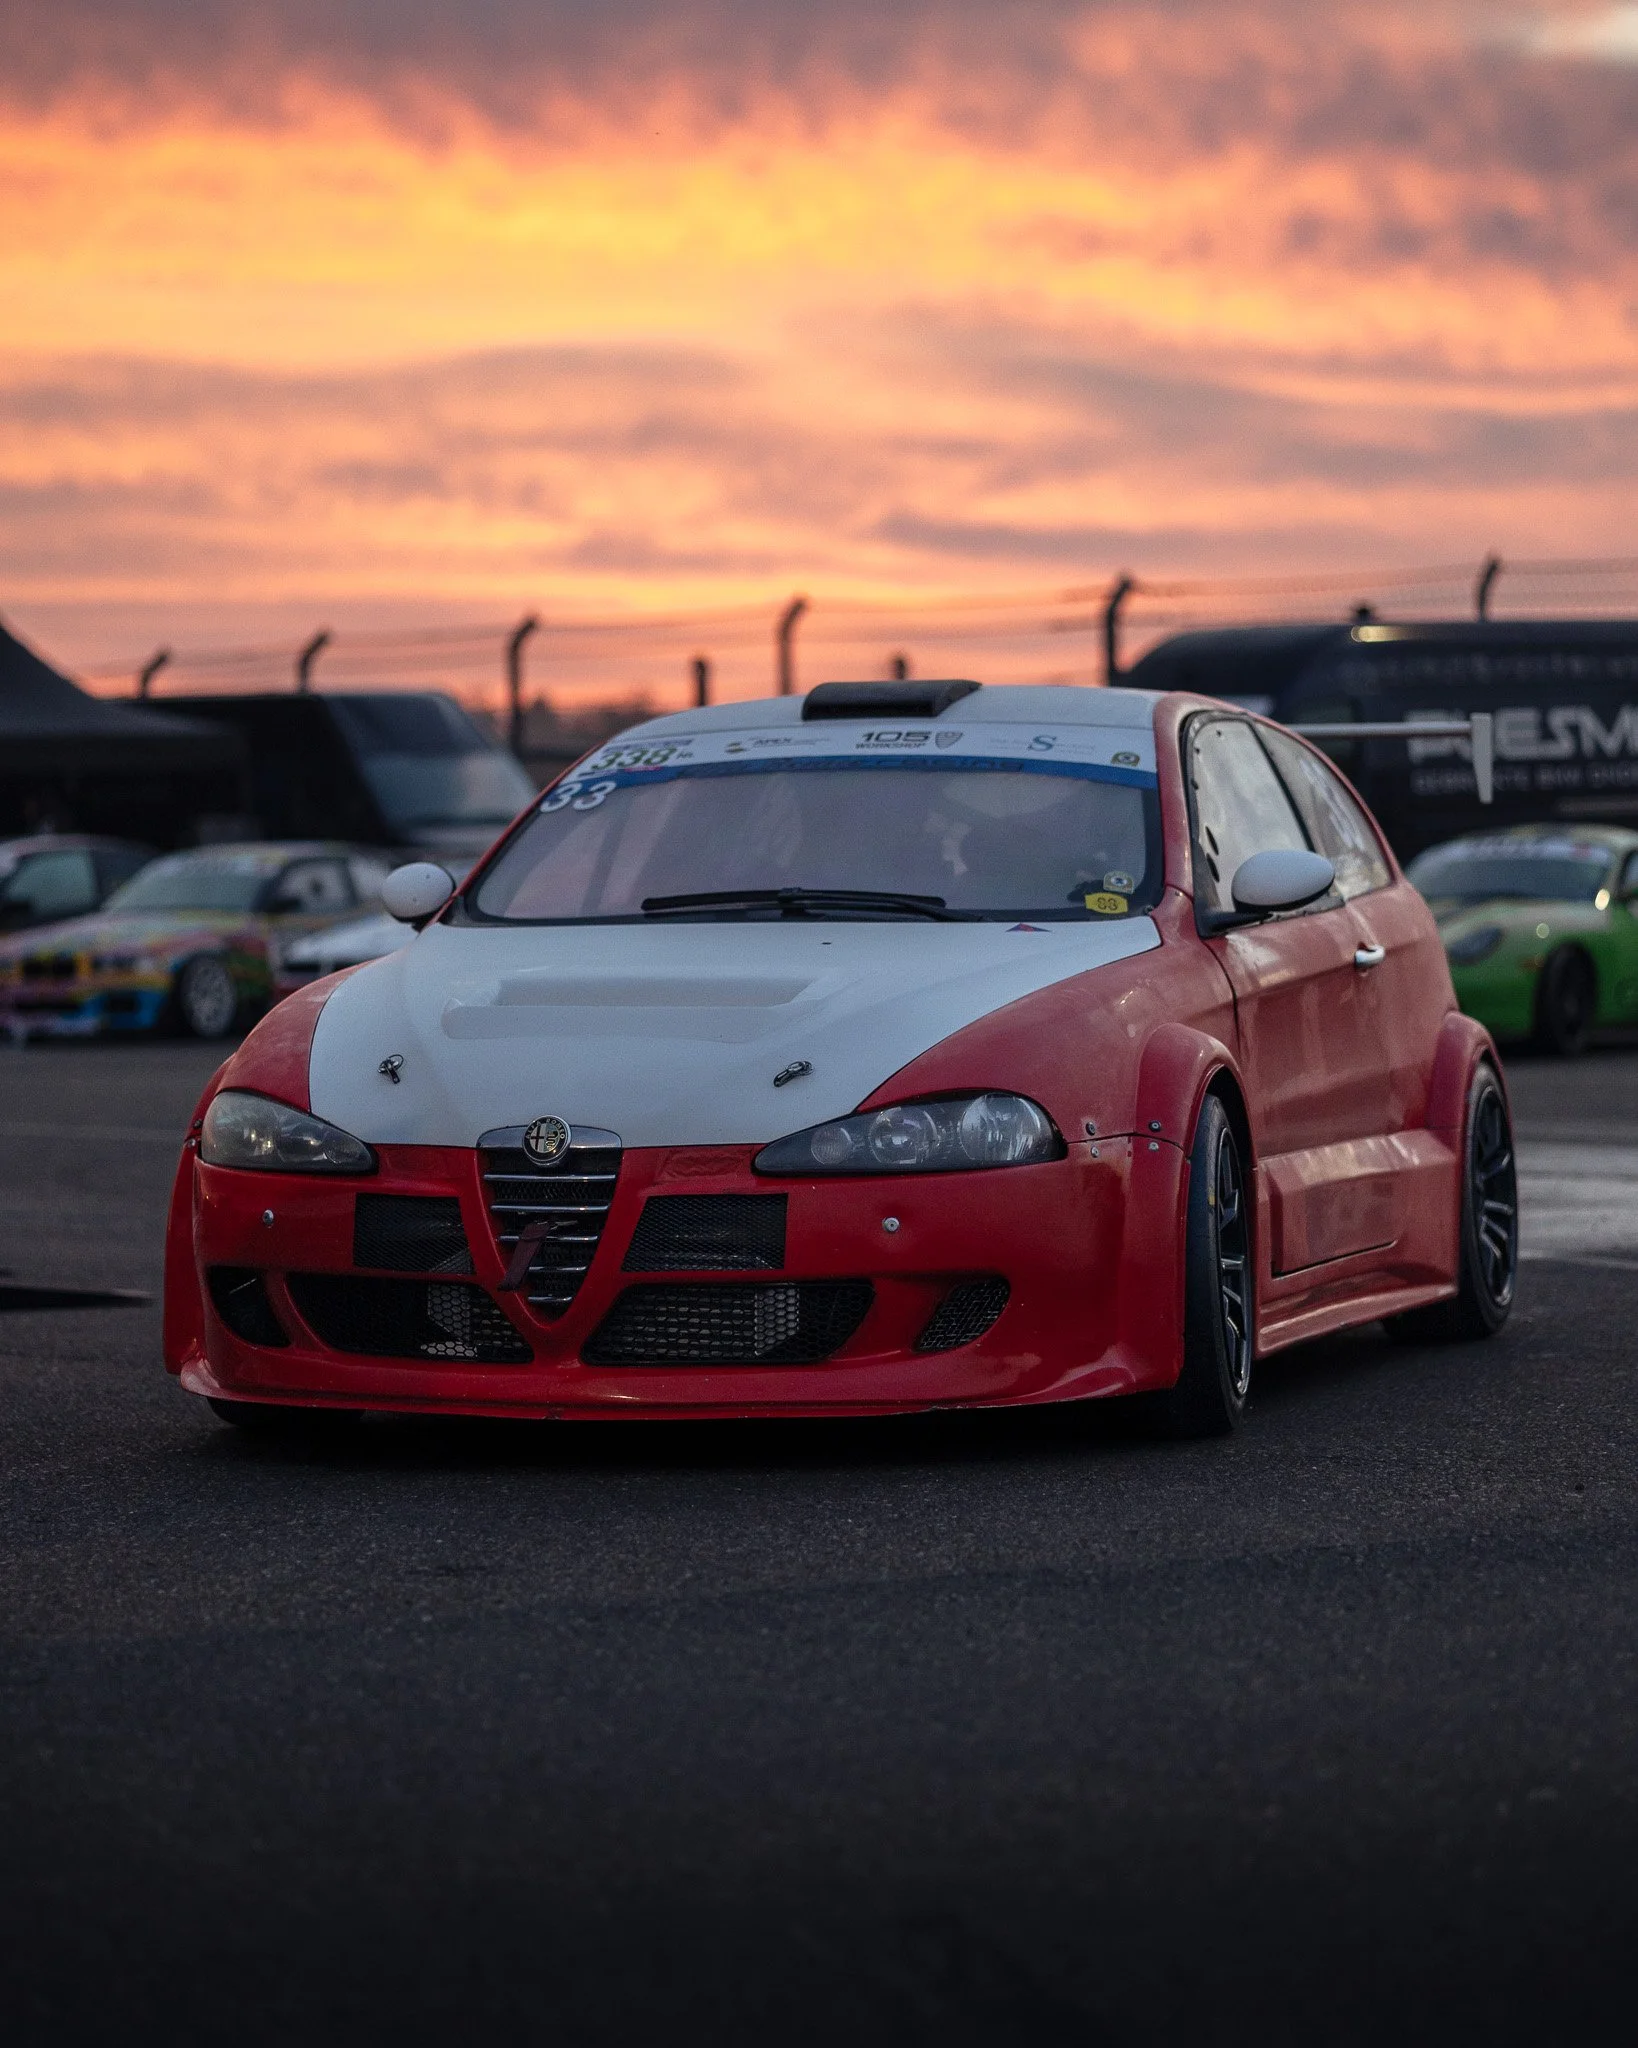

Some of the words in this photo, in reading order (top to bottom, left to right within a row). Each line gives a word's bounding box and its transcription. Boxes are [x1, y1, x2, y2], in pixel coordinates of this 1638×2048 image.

[862, 731, 932, 742] 105
[1027, 735, 1057, 751] S
[591, 746, 677, 770] 338
[540, 781, 617, 813] 33
[546, 1118, 566, 1140] ROMEO
